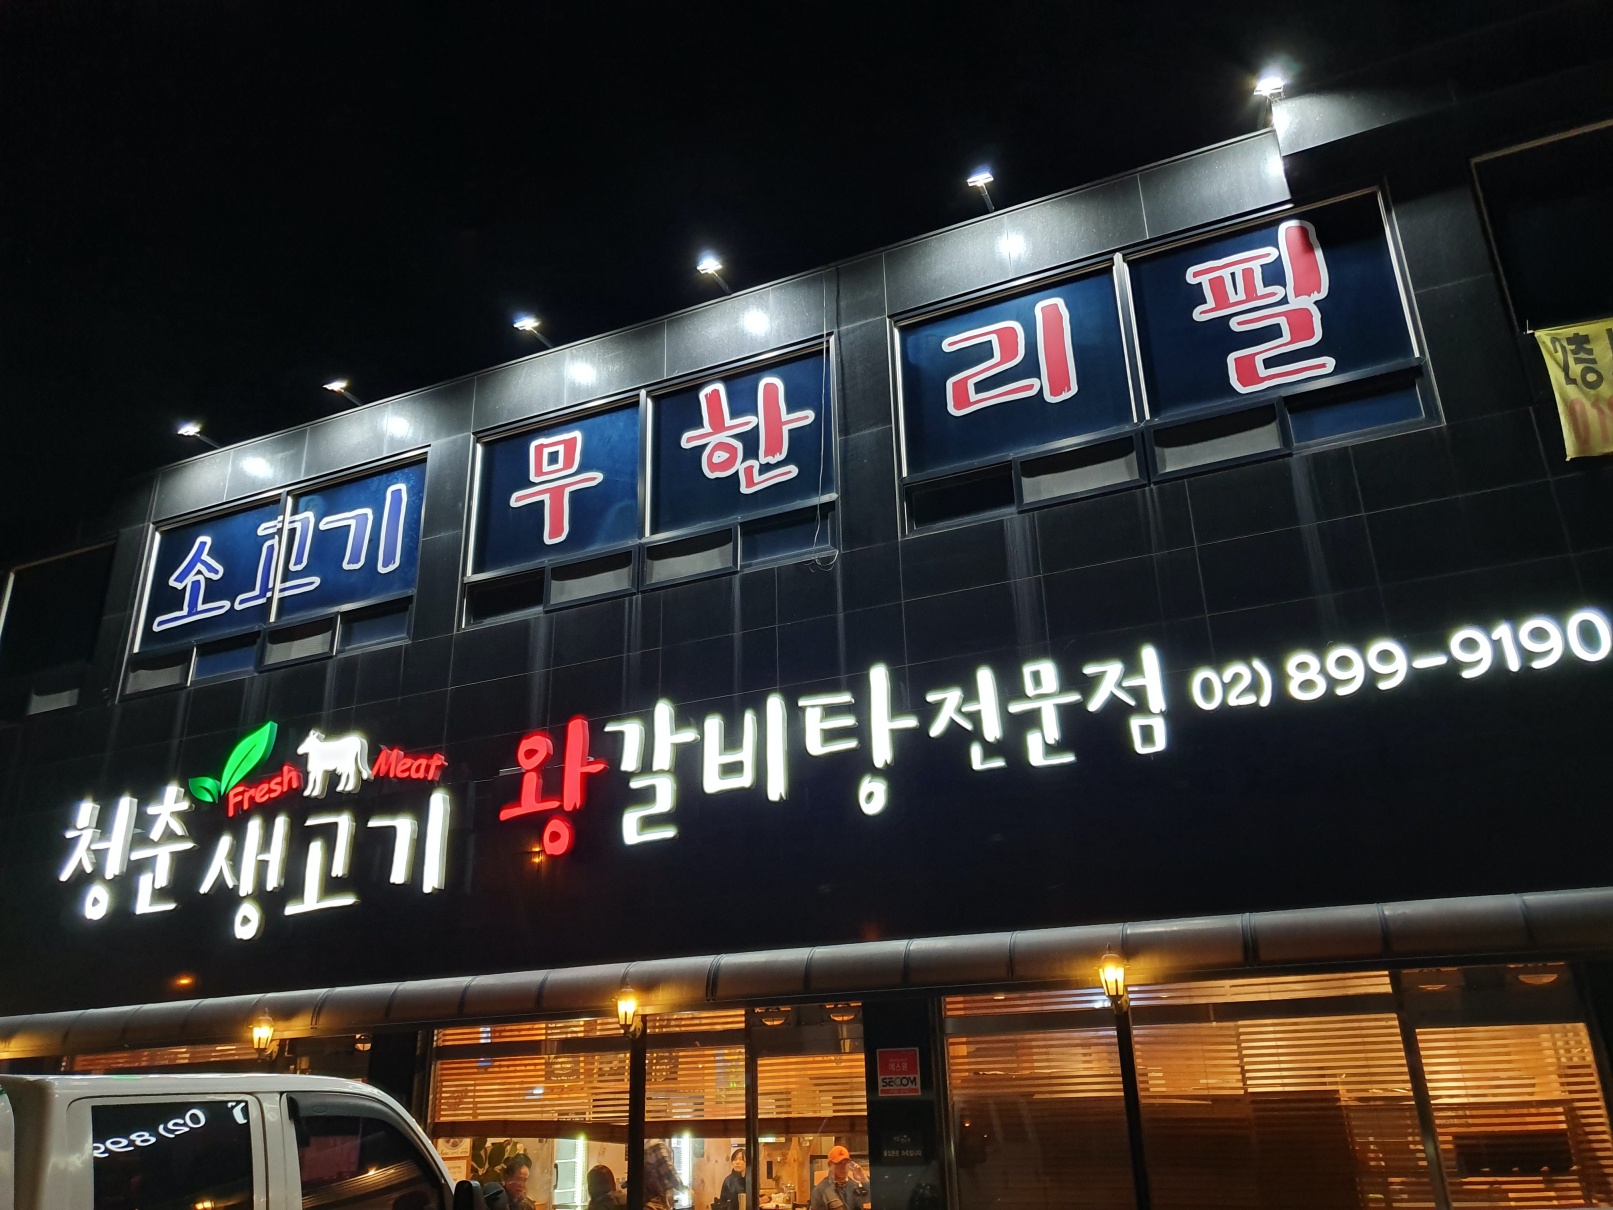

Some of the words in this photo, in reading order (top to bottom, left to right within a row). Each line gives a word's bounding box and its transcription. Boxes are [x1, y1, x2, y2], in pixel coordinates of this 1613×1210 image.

[152, 483, 408, 632] 소고기
[1285, 608, 1612, 702] 899-9190
[228, 763, 304, 818] Fresh
[371, 746, 449, 783] Meat
[881, 1076, 917, 1088] SECOM
